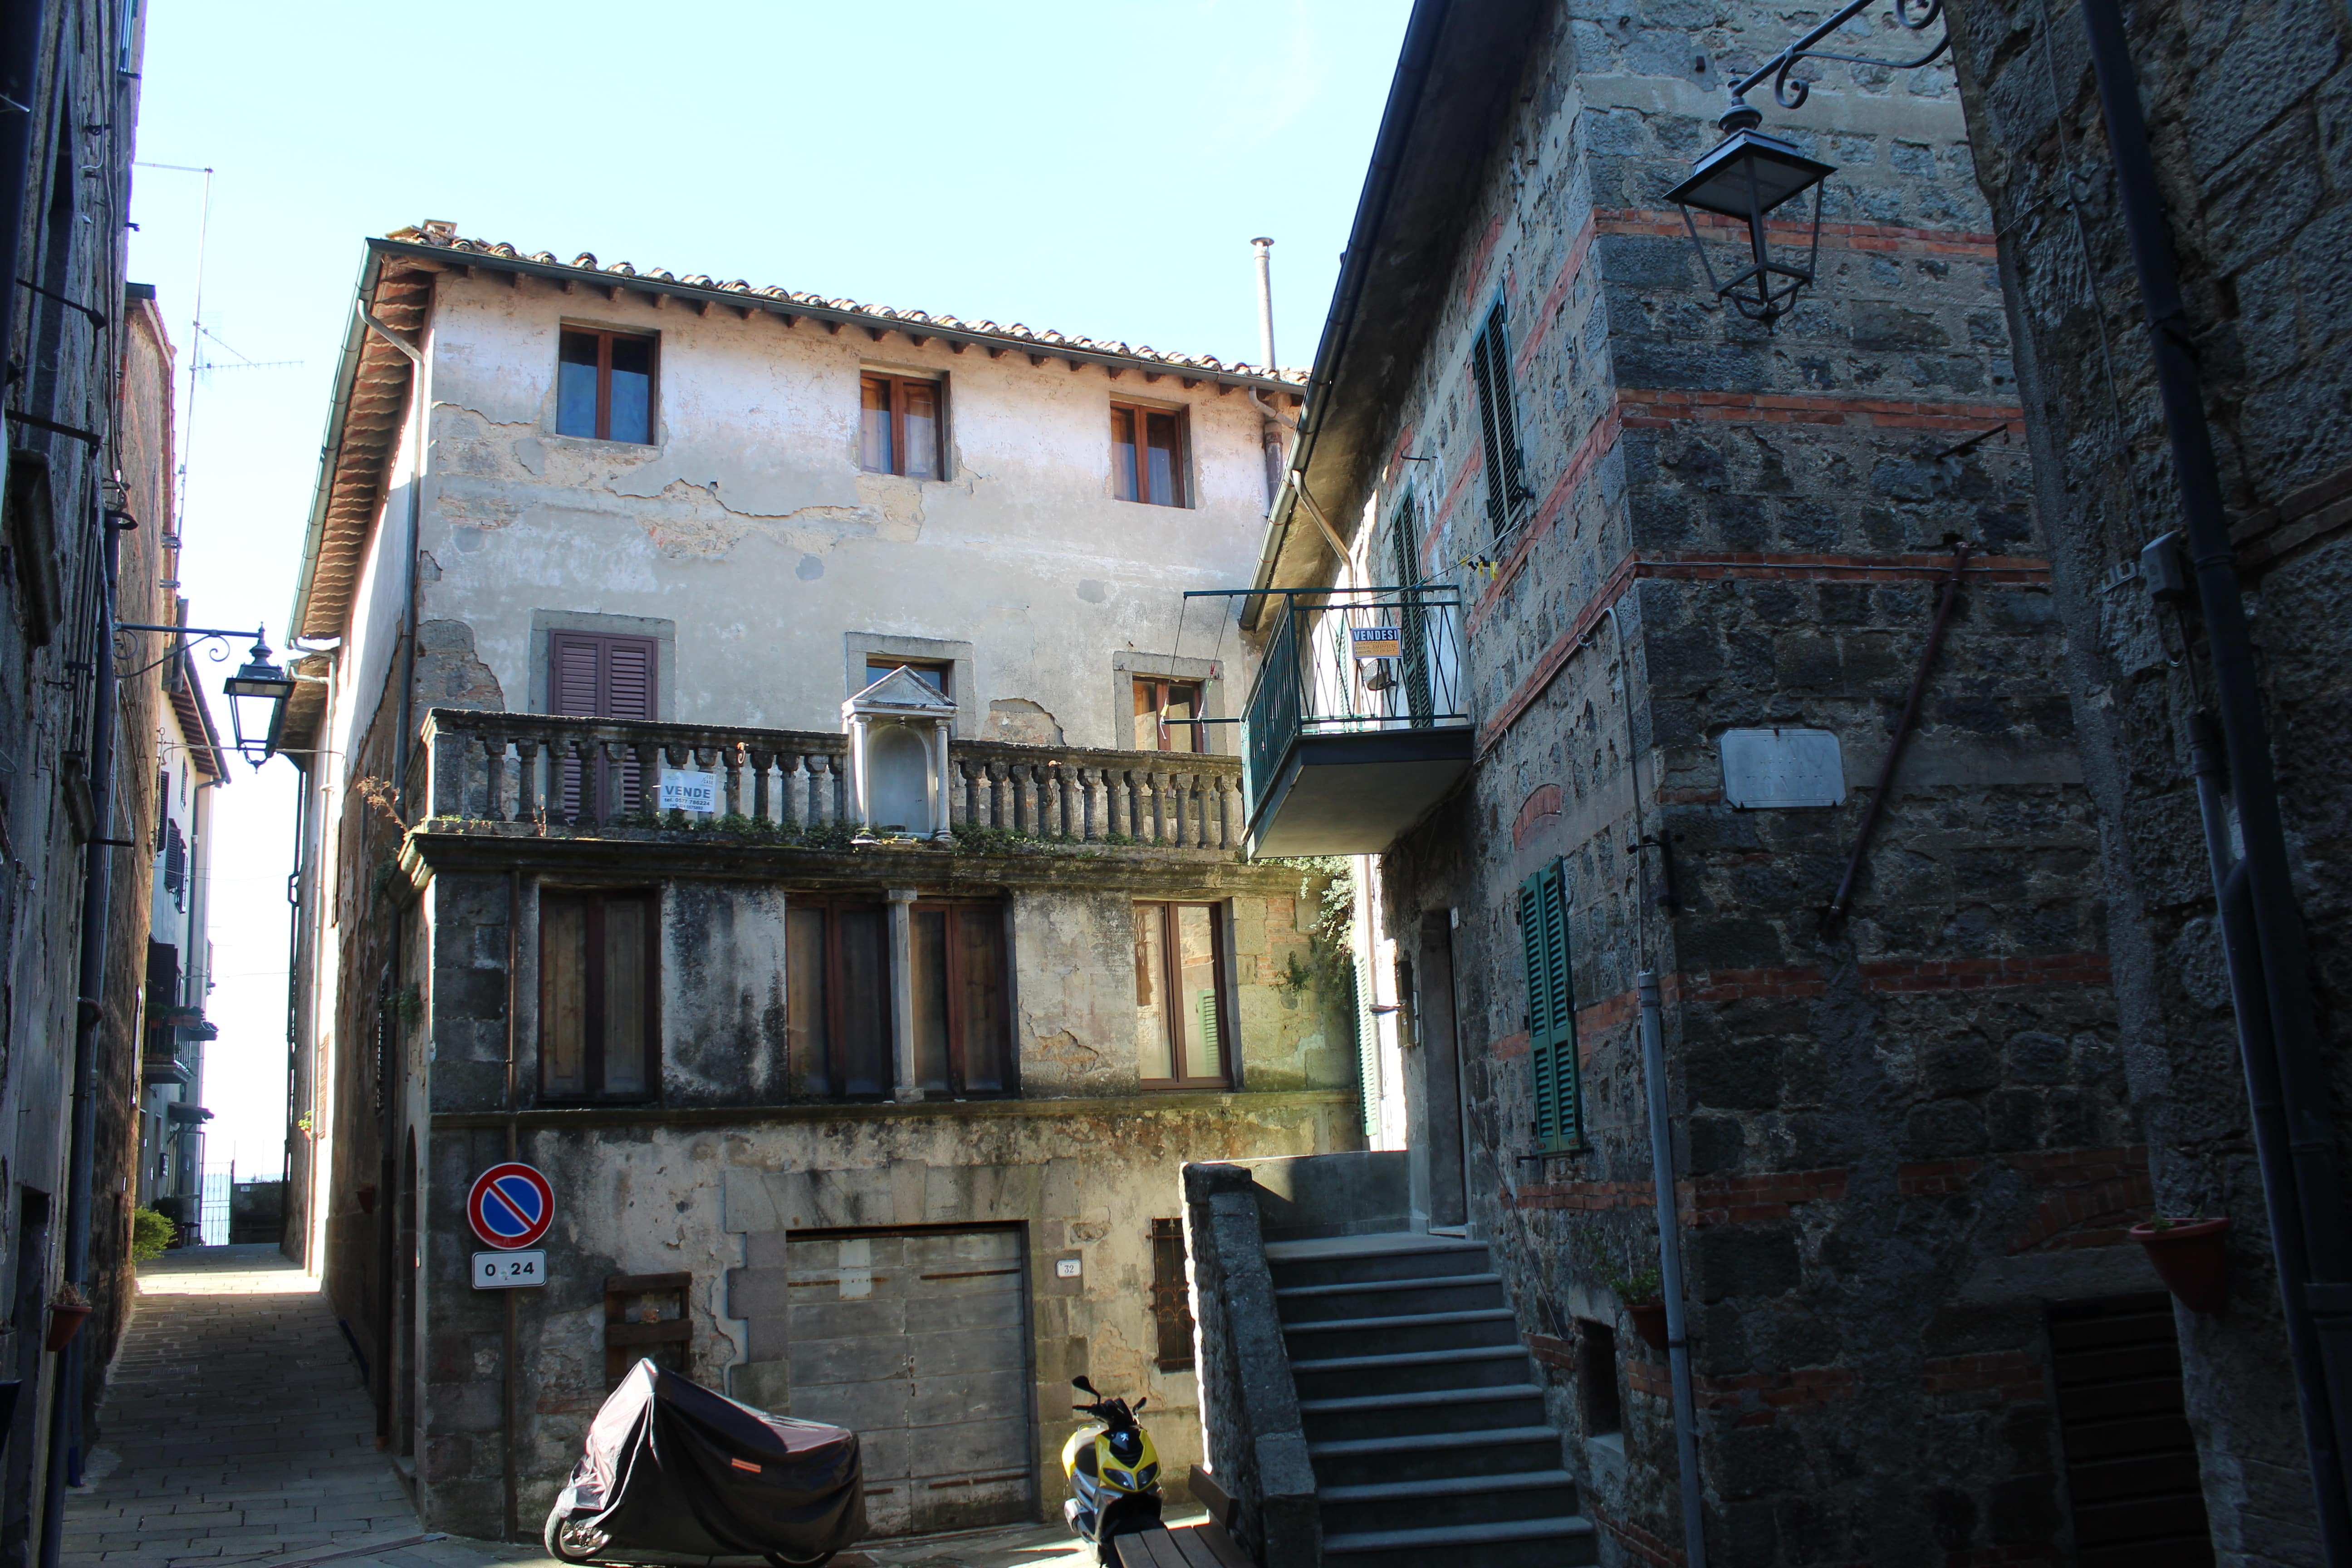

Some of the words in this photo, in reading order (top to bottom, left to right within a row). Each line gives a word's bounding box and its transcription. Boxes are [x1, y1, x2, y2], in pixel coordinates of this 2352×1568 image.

[1353, 630, 1397, 641] VENDESI
[665, 785, 711, 799] VENDE
[511, 1262, 534, 1275] 24
[1064, 1264, 1074, 1274] 32
